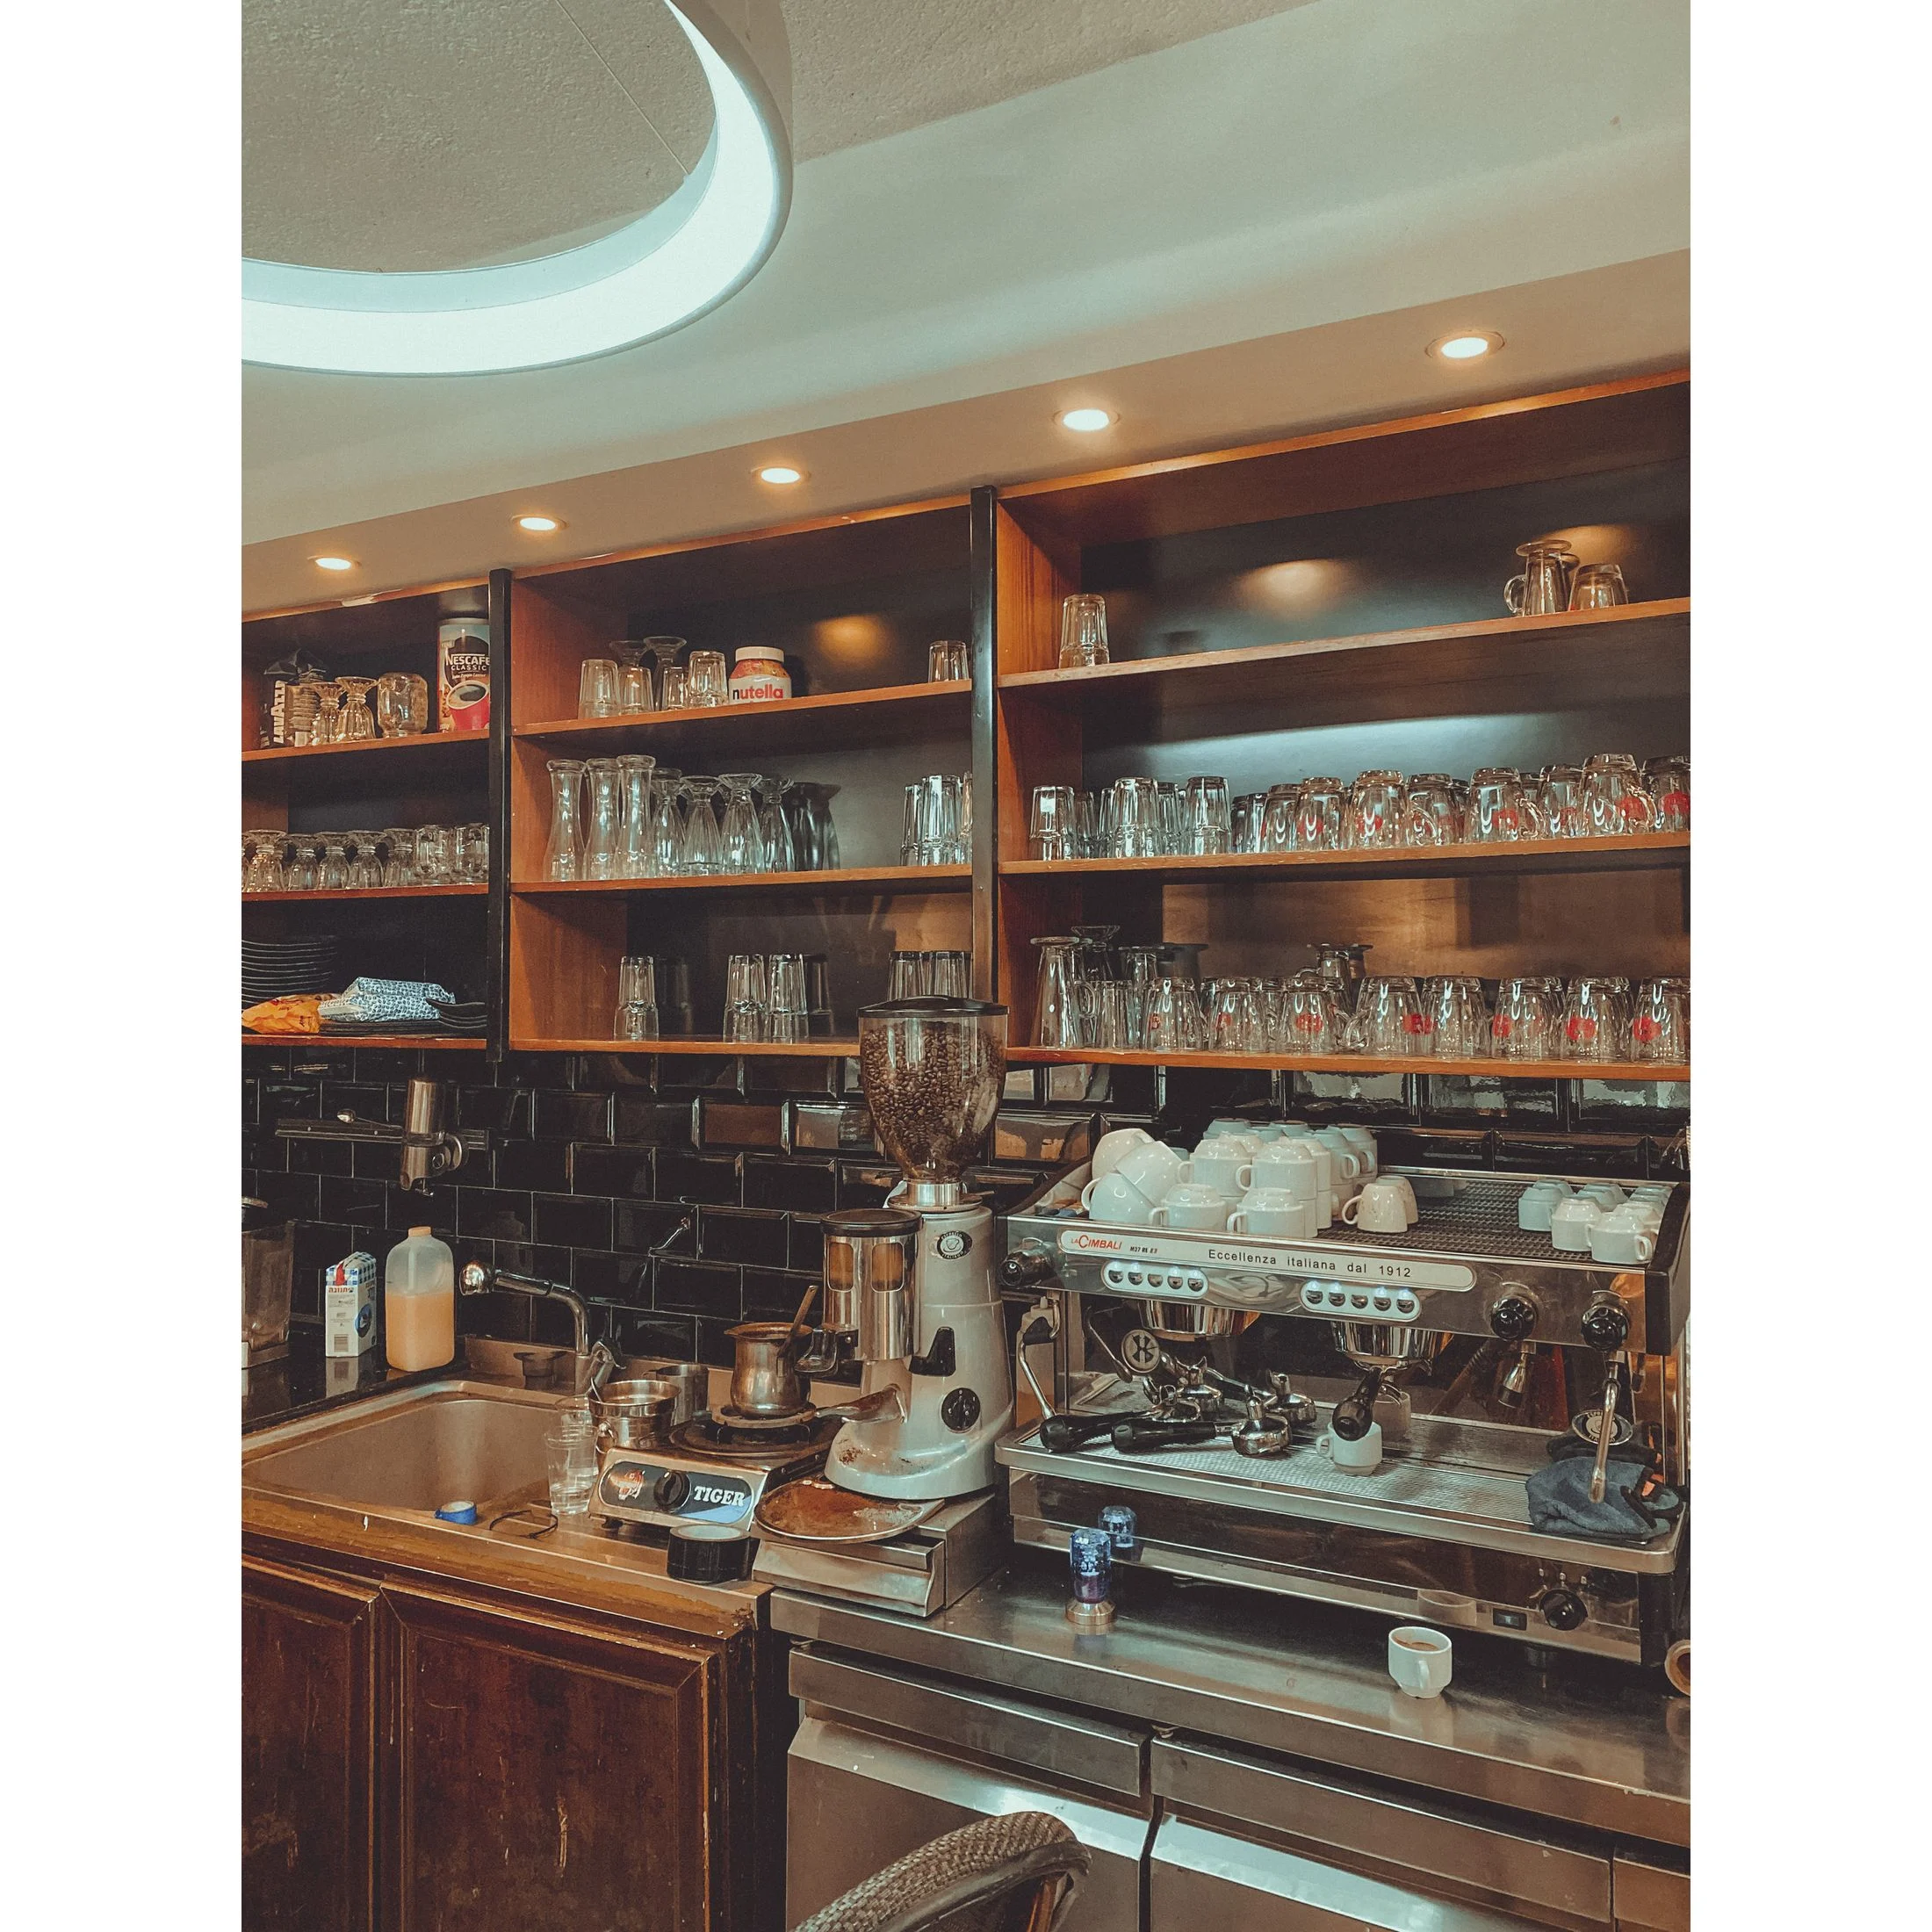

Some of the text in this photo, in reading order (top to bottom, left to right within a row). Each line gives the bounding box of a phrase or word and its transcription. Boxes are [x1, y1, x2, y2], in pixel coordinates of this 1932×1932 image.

[732, 684, 783, 700] nutella
[1208, 1249, 1411, 1278] Eccellenza italiana dal 1912
[693, 1485, 746, 1507] TIGER
